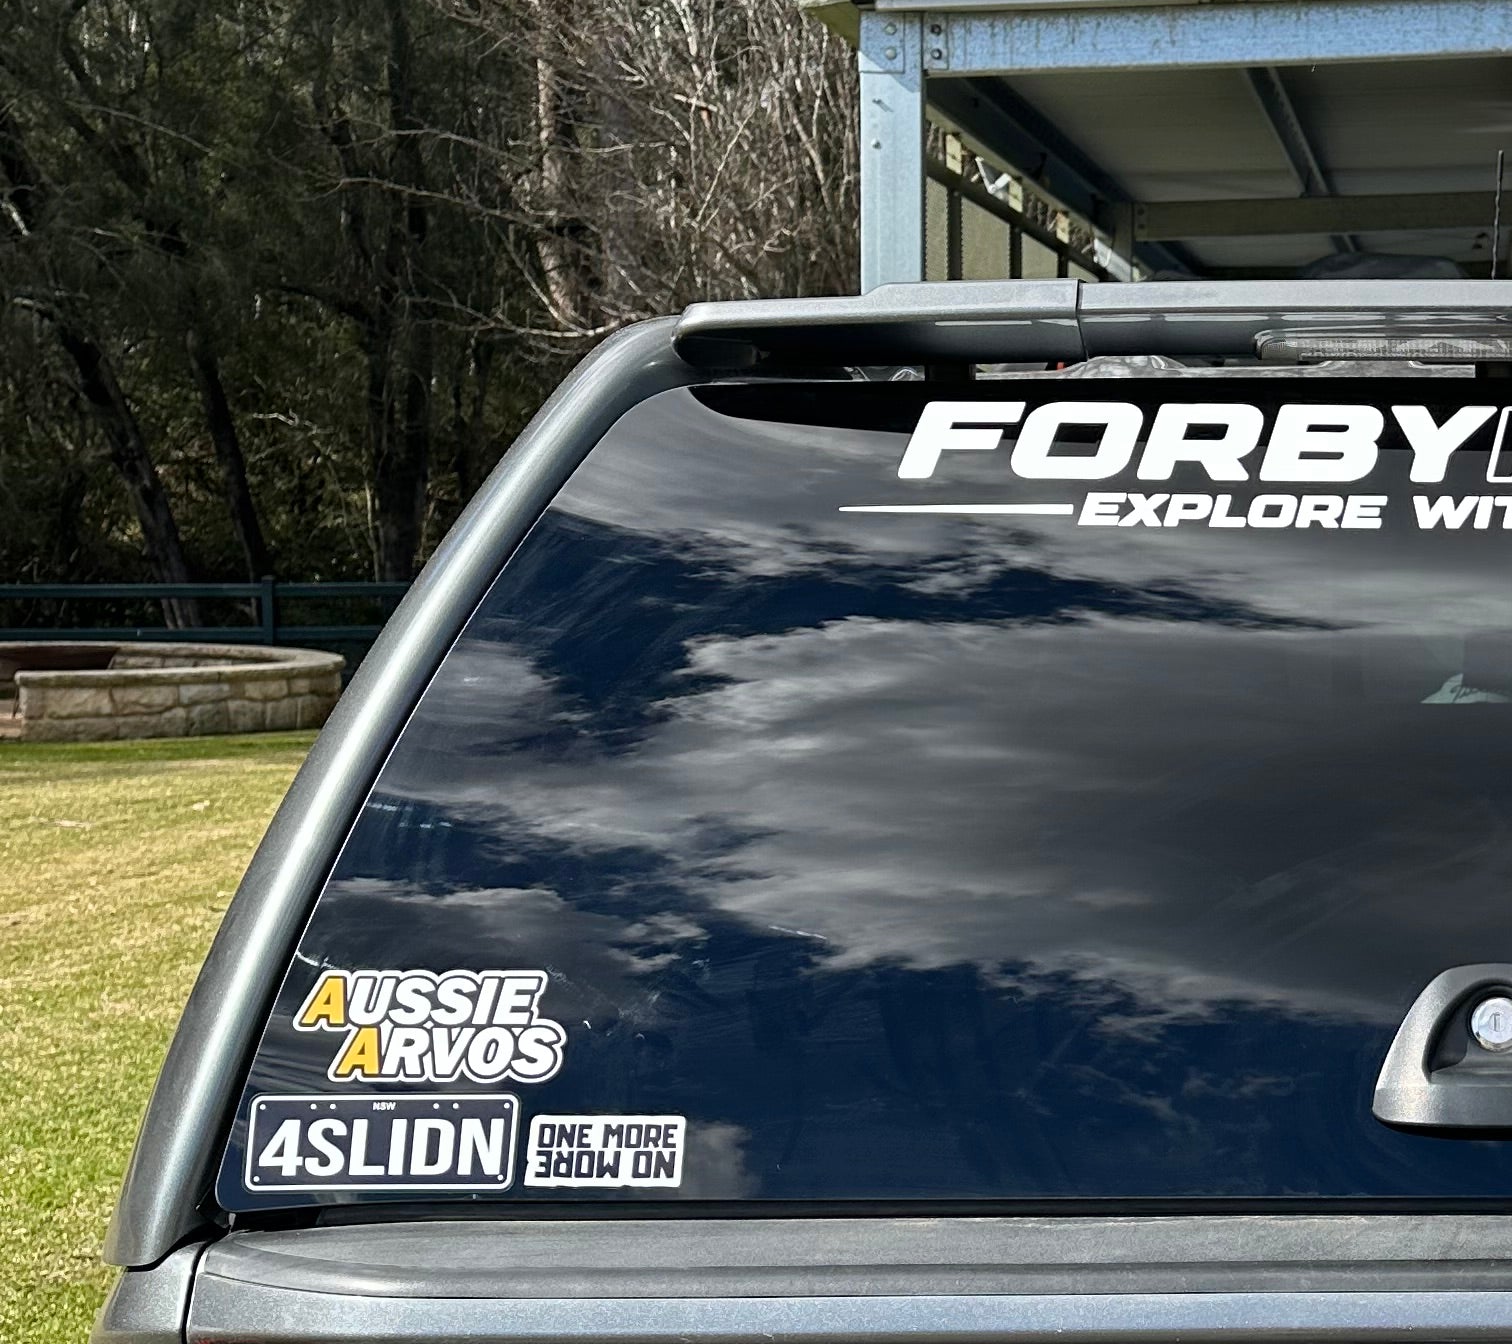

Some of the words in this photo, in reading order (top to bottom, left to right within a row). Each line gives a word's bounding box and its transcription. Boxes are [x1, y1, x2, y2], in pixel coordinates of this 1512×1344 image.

[1077, 492, 1388, 529] EXPLORE
[300, 974, 542, 1026] AUSSIE
[336, 1024, 562, 1078] ARVOS
[372, 1101, 397, 1111] NSW
[258, 1117, 505, 1176] 4SLIDN
[537, 1123, 593, 1149] ONE
[602, 1123, 678, 1149] MORE
